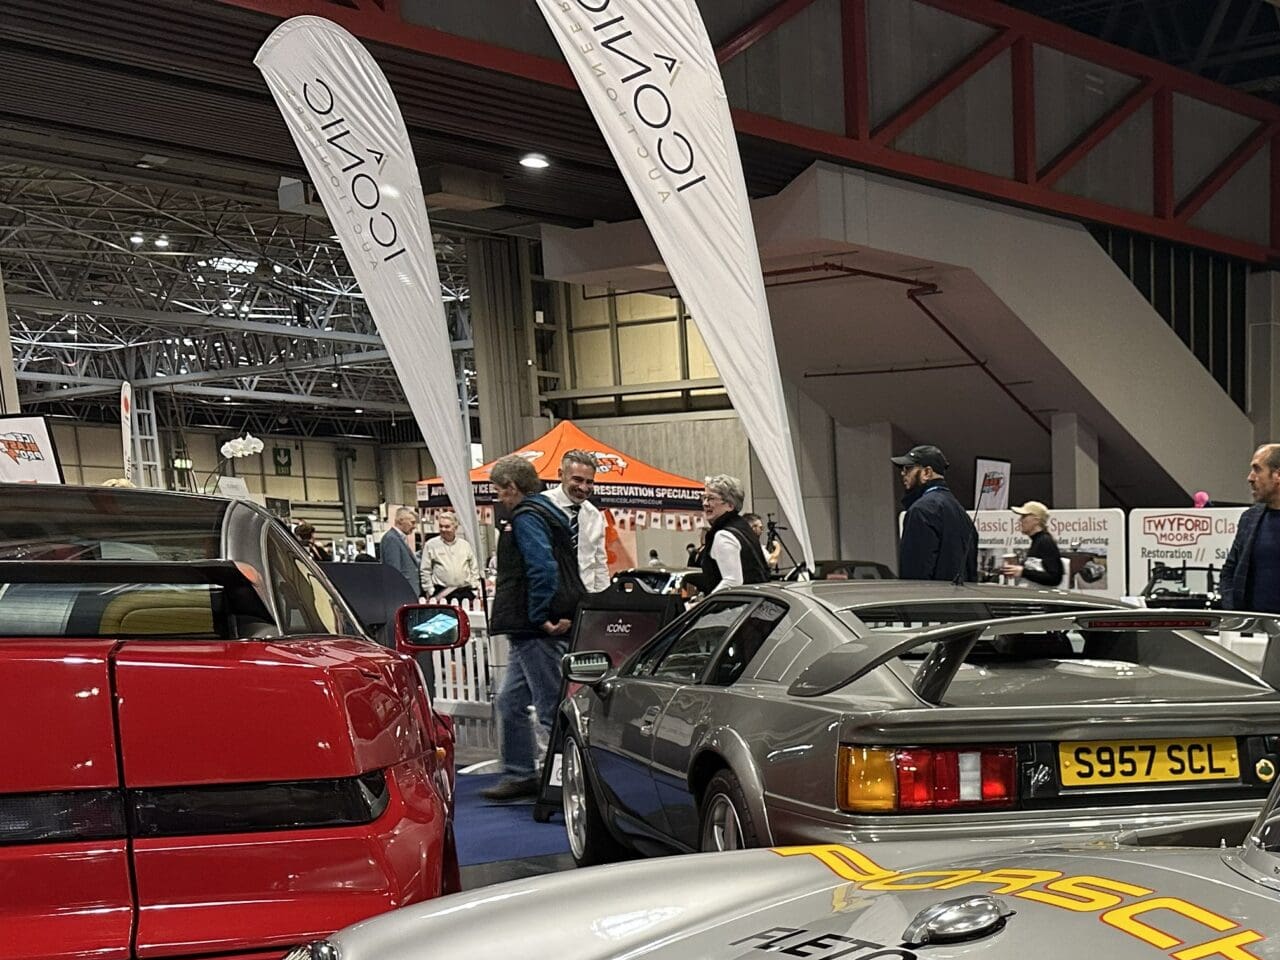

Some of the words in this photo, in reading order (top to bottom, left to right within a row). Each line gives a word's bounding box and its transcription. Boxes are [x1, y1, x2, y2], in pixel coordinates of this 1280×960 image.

[594, 485, 655, 498] RESERVATION
[976, 517, 1008, 532] lassic
[1051, 517, 1108, 535] Specialist
[1146, 516, 1211, 533] TWYFORD
[1159, 532, 1196, 543] MOORS
[1141, 547, 1193, 560] Restoration
[606, 624, 632, 633] ICONIC
[1073, 745, 1158, 779] S957
[1166, 742, 1228, 776] SCL
